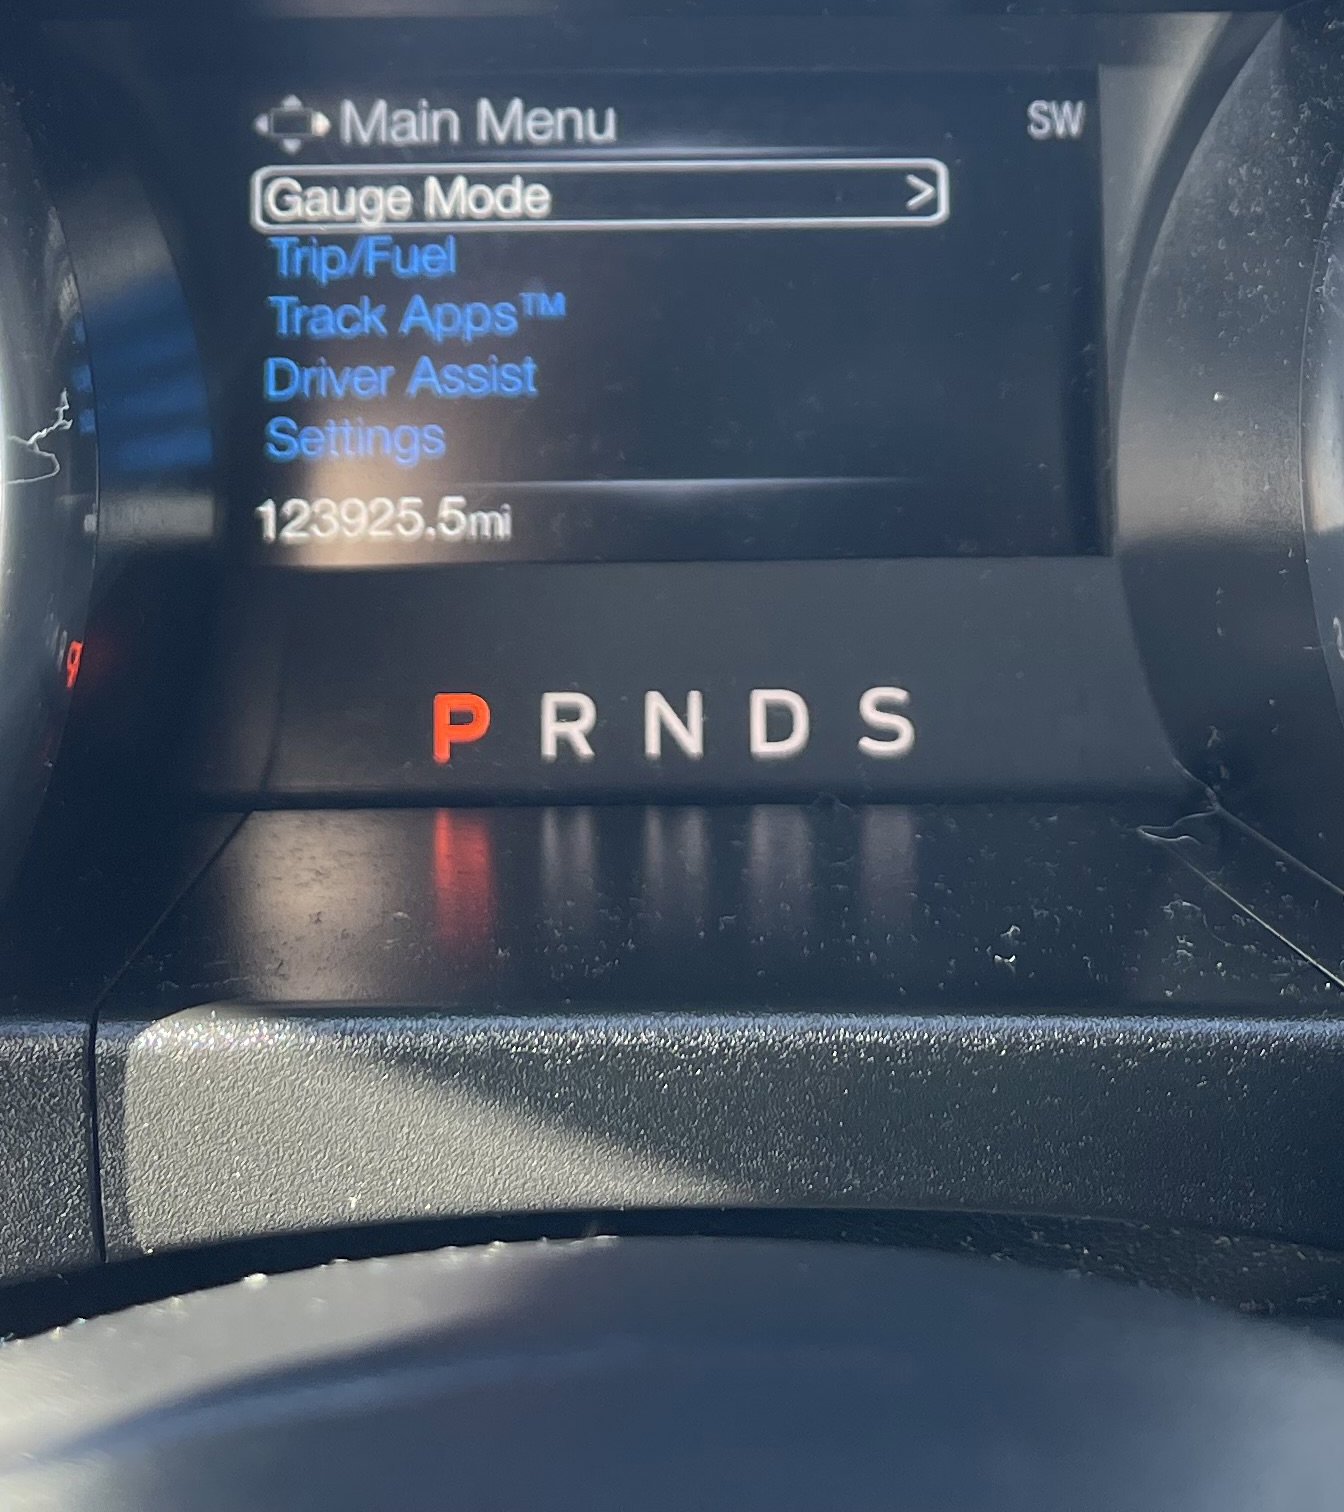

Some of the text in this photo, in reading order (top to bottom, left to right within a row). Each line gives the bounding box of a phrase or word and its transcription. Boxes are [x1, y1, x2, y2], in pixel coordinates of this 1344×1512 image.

[340, 97, 617, 144] Main Menu
[1027, 99, 1085, 139] SW
[267, 175, 552, 226] Gauge Mode
[268, 235, 456, 284] Trip/Fuel
[268, 296, 387, 338] Track
[264, 354, 538, 402] Driver Assist
[265, 416, 446, 467] Settings
[432, 687, 915, 763] P R N D S
